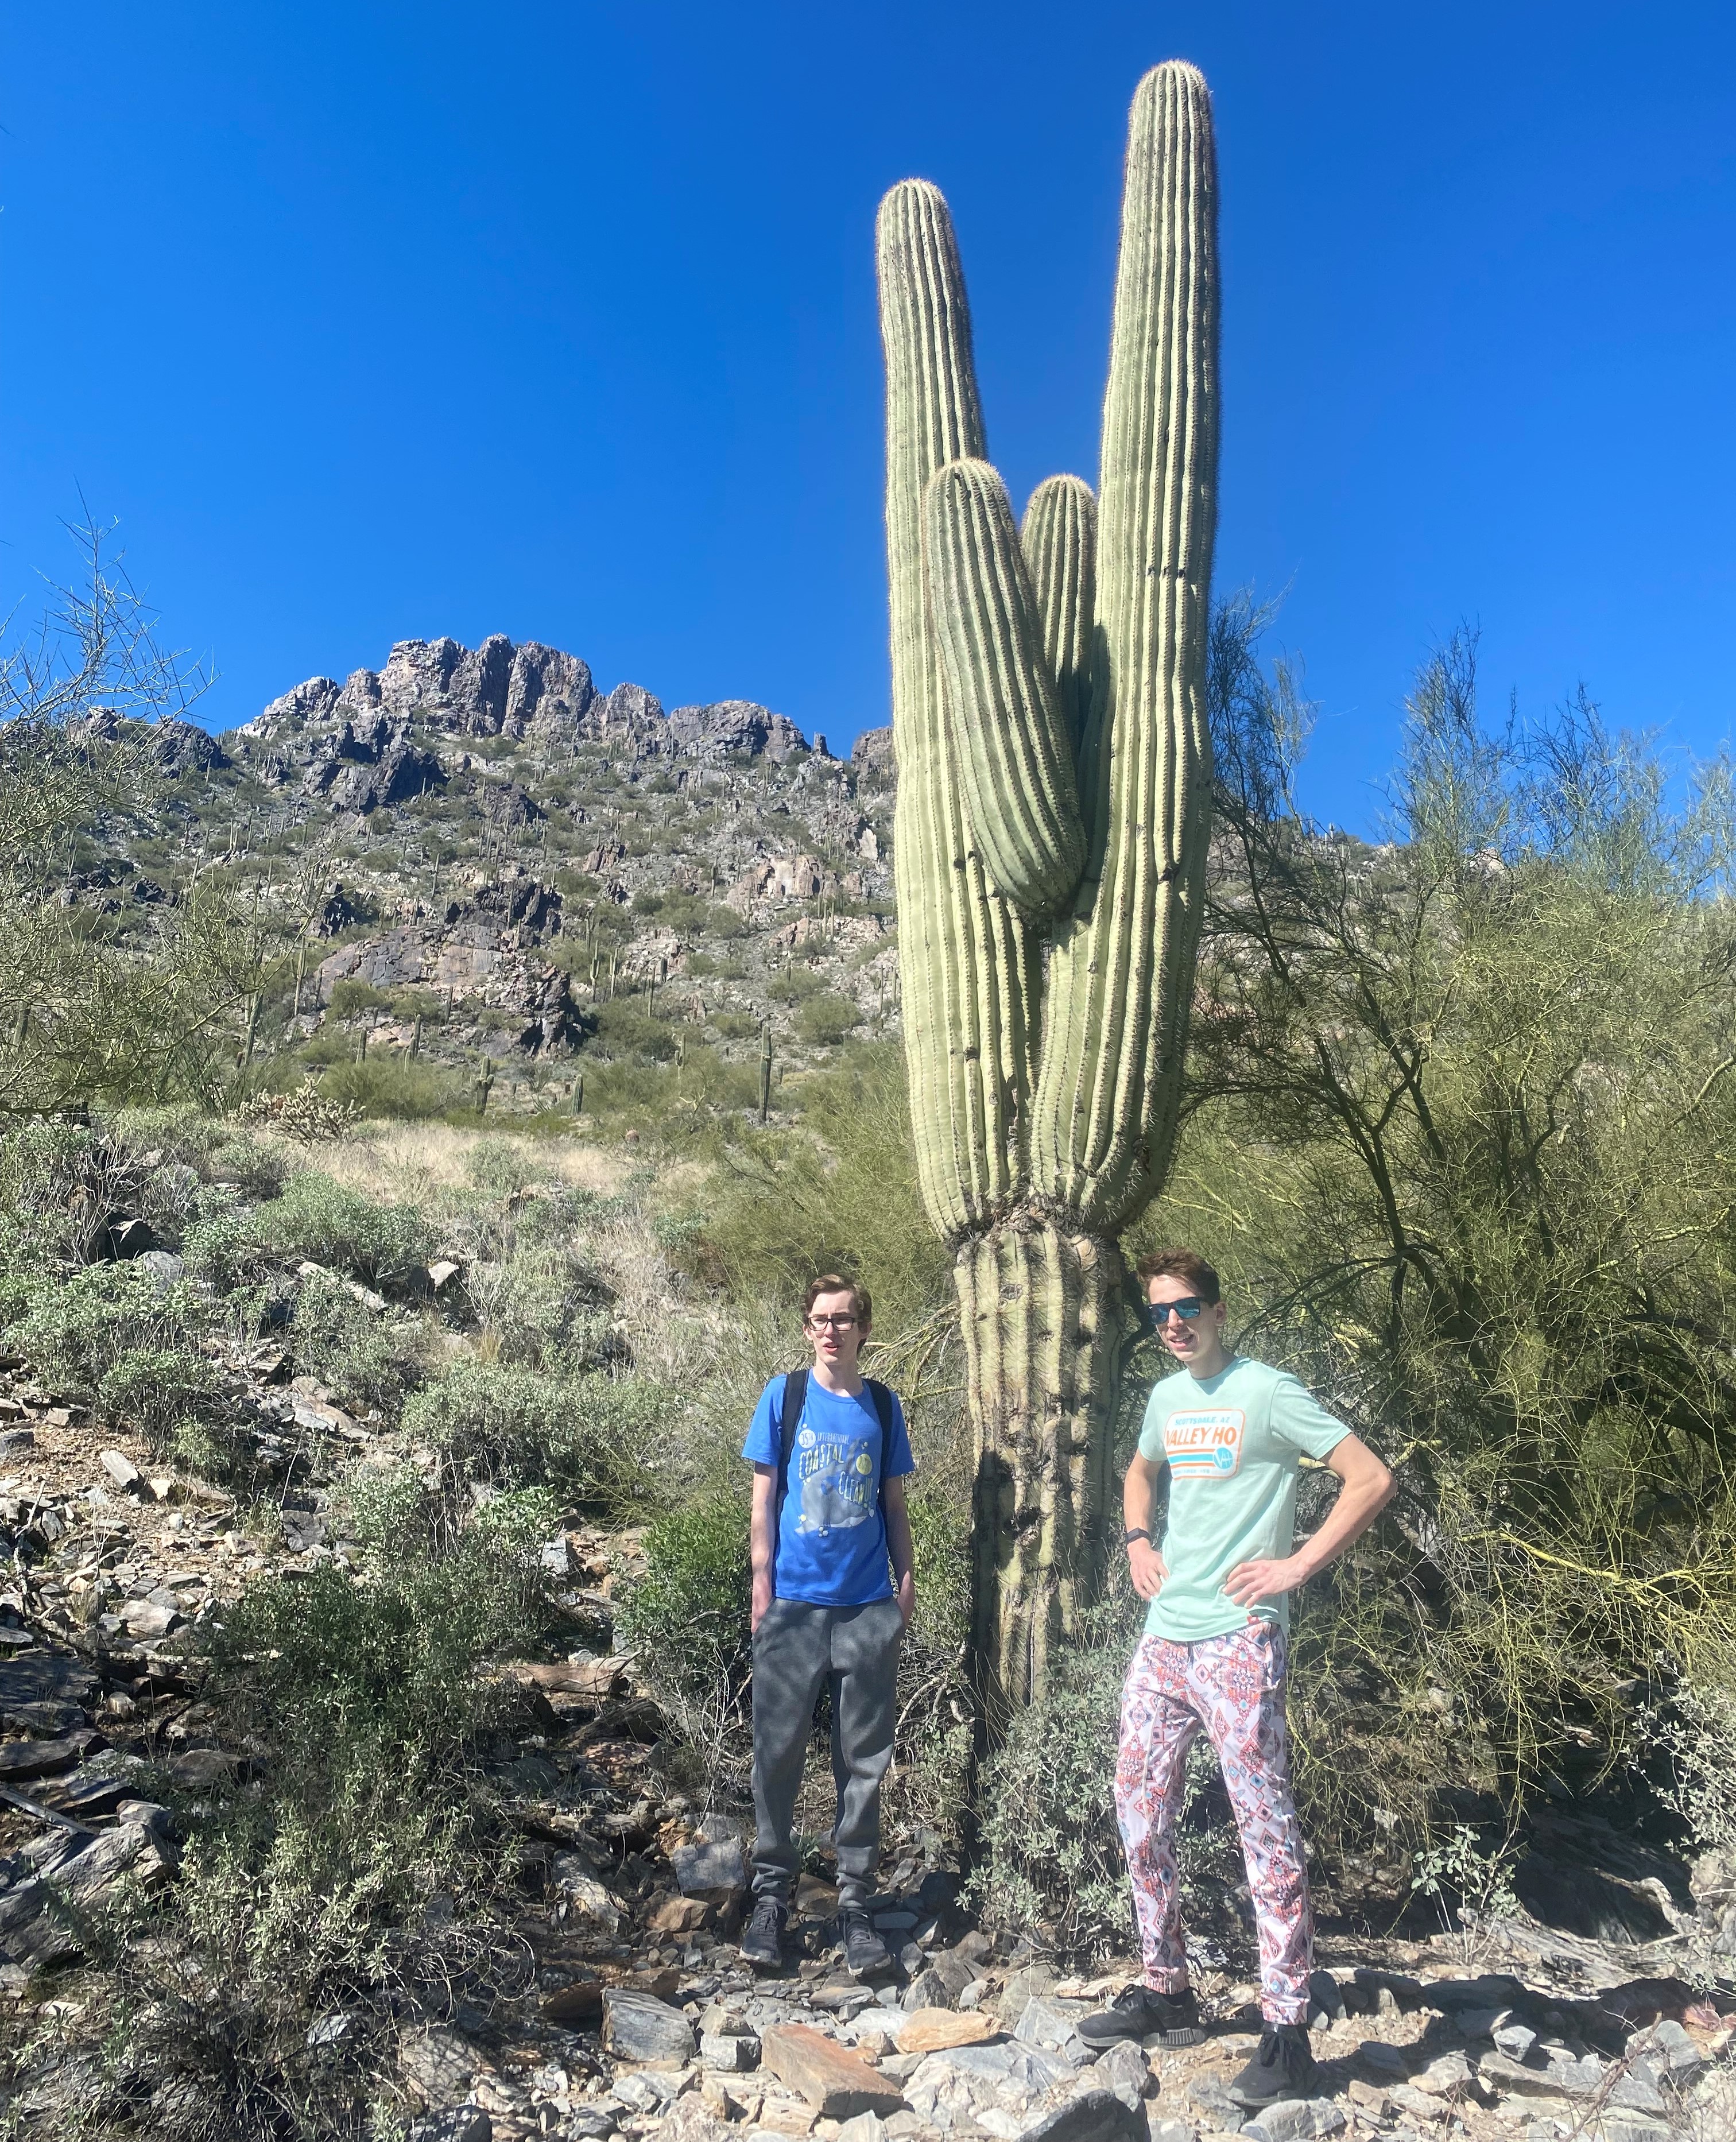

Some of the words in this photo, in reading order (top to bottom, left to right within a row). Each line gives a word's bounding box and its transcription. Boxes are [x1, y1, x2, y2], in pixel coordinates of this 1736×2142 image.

[817, 1432, 850, 1445] INTERNATIONAL
[1167, 1427, 1212, 1447] VALLEY
[1211, 1427, 1237, 1446] HO
[799, 1443, 844, 1479] COASTAL
[839, 1471, 873, 1505] CLEANUP
